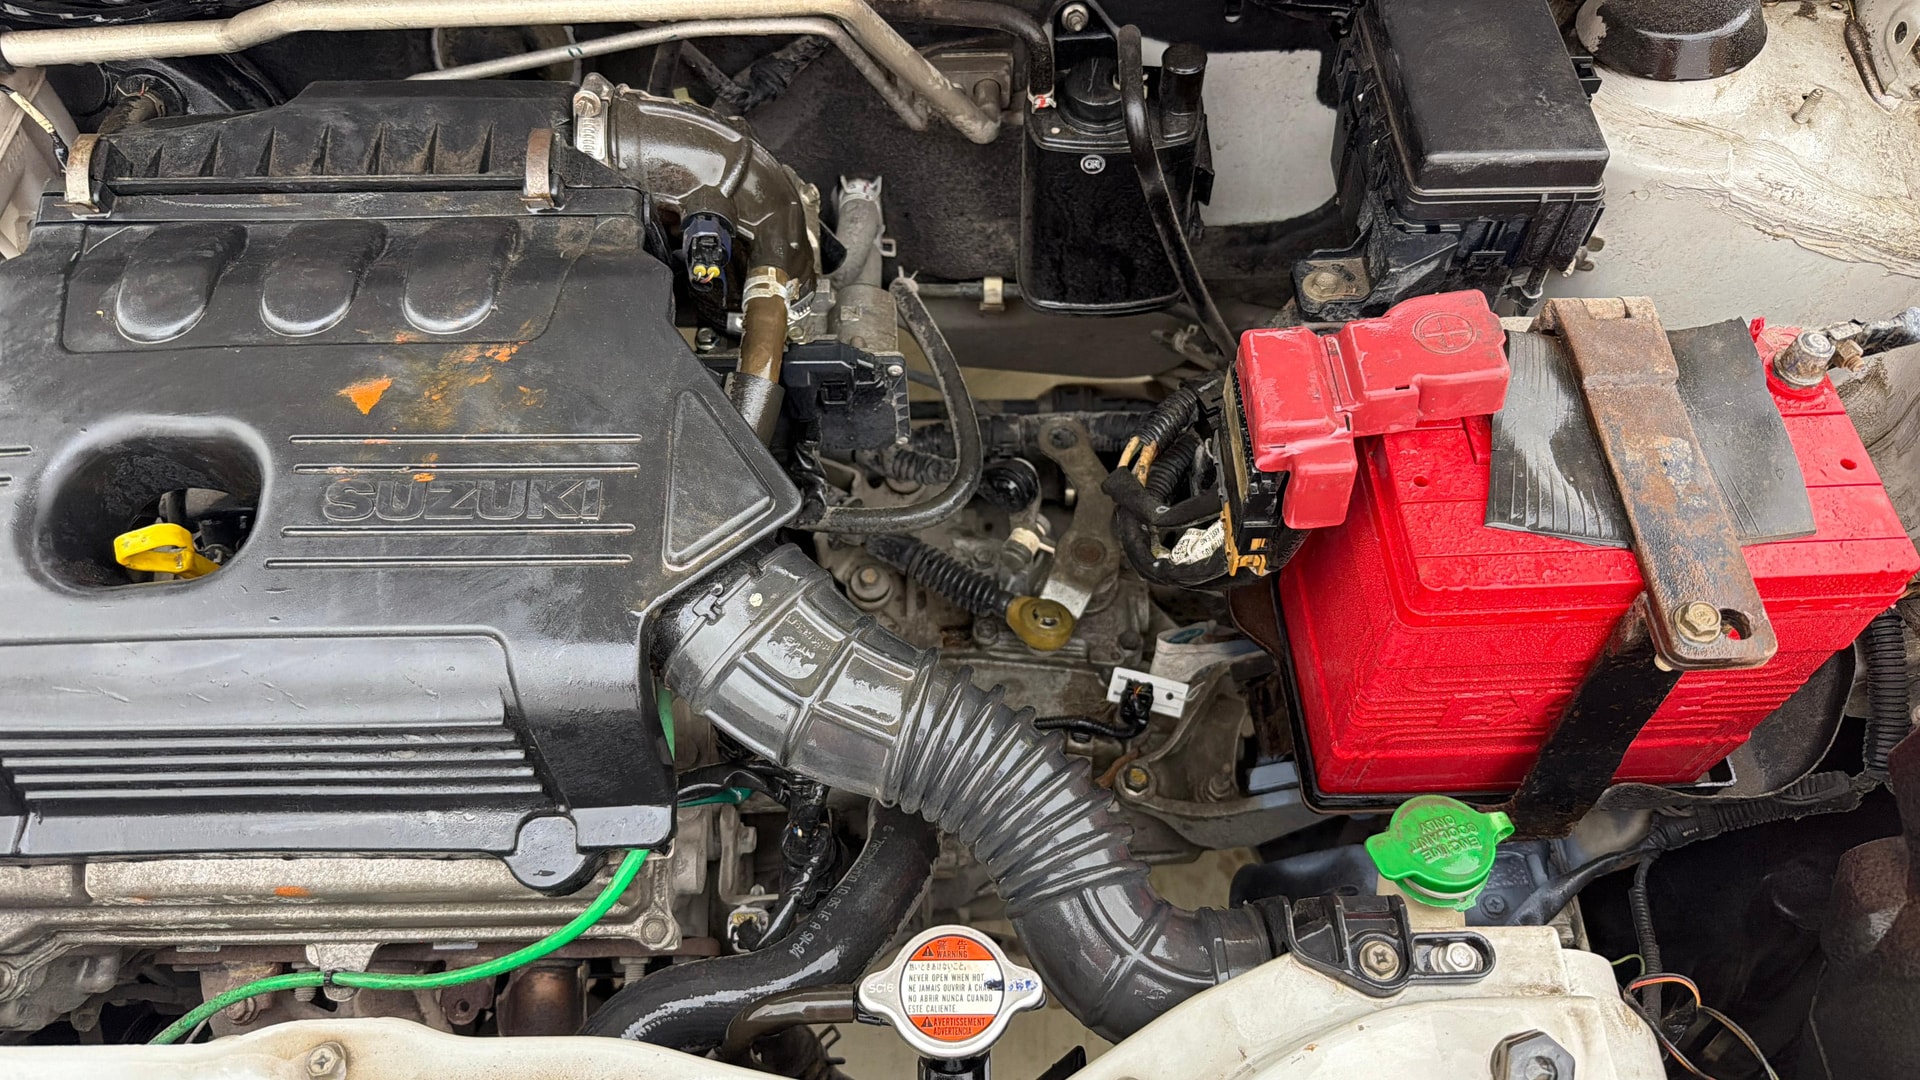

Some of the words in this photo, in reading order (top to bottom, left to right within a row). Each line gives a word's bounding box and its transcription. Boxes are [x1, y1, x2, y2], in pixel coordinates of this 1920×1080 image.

[322, 478, 604, 521] SUZUKI
[1420, 815, 1456, 835] ONLY
[1409, 823, 1479, 854] COOLANT
[1421, 836, 1483, 864] ENGINE
[909, 974, 929, 982] NEVER
[932, 974, 949, 982] OPEN
[951, 974, 970, 982] WHEN
[869, 983, 894, 993] SC16
[908, 984, 916, 992] NE
[919, 984, 941, 992] JAMAIS
[943, 984, 965, 992] OUVRIR
[908, 994, 917, 1002] NO
[920, 994, 939, 1002] ABRIR
[942, 994, 964, 1002] NUNCA
[966, 994, 993, 1002] CUANDO
[934, 1017, 986, 1026] AVERTISSEMENT
[934, 1027, 972, 1035] ADVERTENCIA
